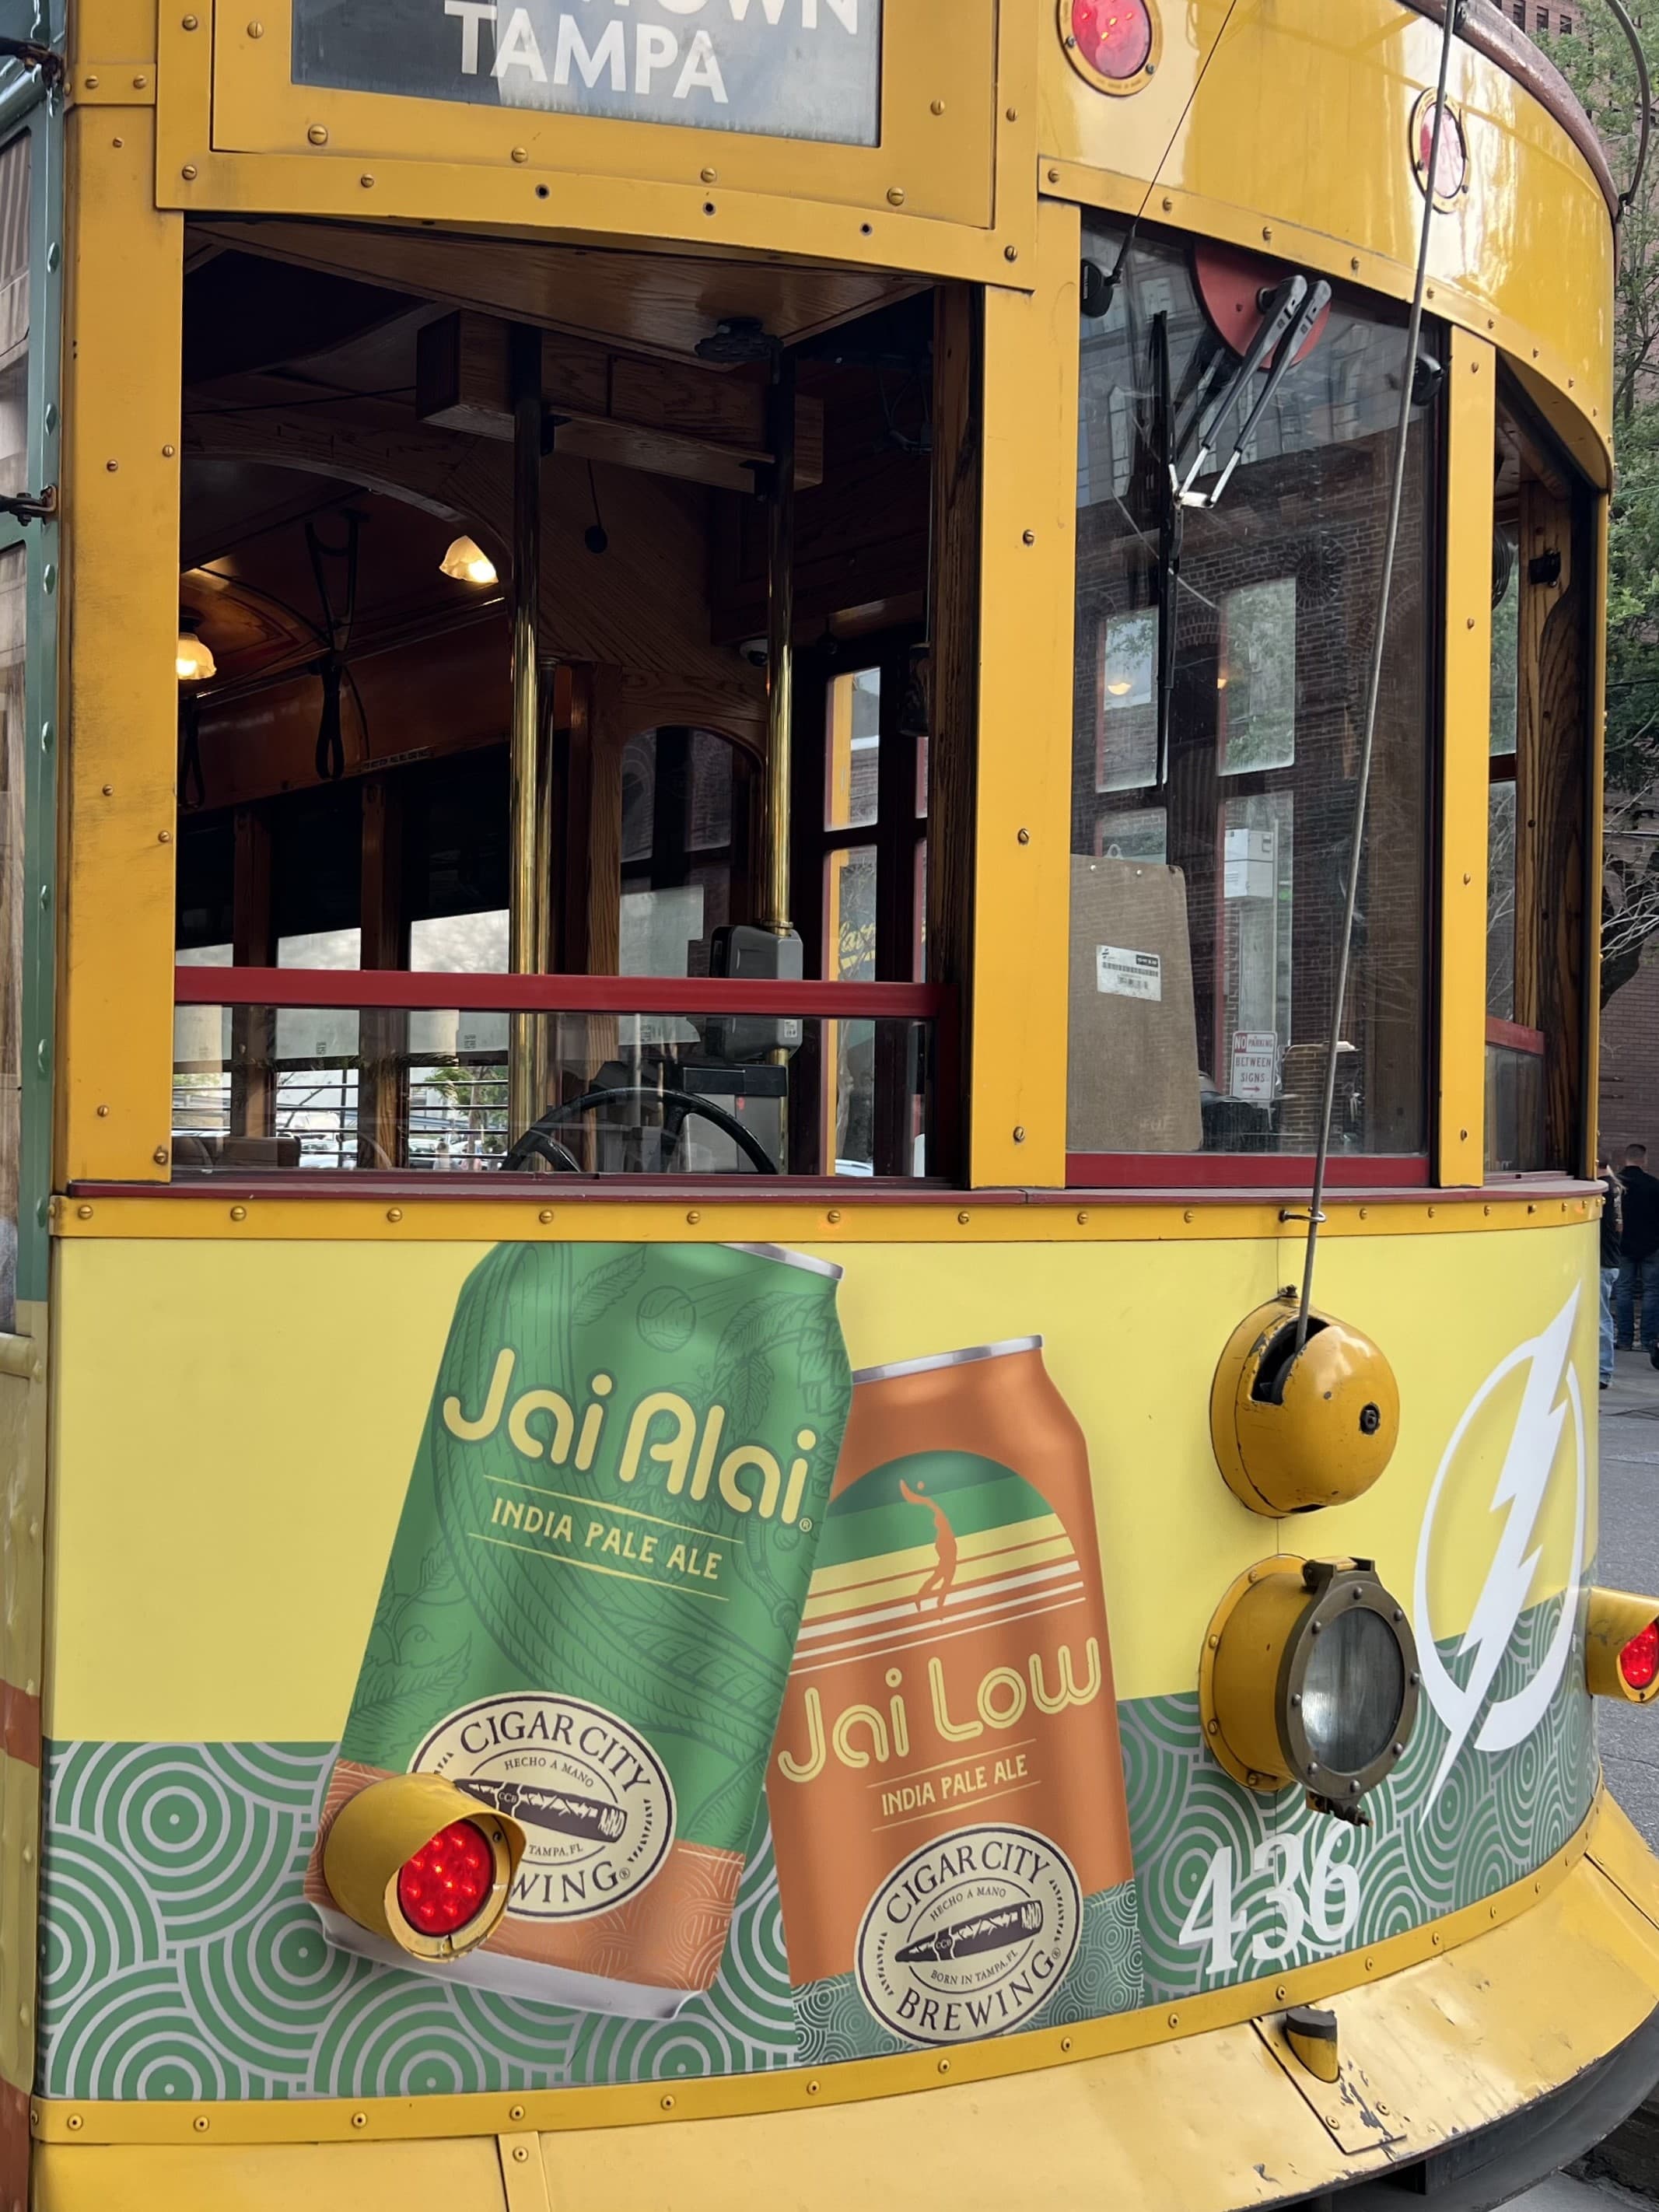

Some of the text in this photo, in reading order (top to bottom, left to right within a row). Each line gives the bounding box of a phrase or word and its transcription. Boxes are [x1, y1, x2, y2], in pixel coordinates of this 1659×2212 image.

[444, 1, 729, 103] TAMPA
[1234, 1035, 1273, 1049] NO PARKING
[1235, 1056, 1272, 1067] BETWEEN
[1240, 1073, 1265, 1083] SIGNS
[443, 1348, 613, 1471] Jai
[491, 1498, 723, 1580] INDIA PALE ALE
[778, 1636, 1102, 1783] Jai Low
[460, 1711, 651, 1792] CIGAR CITY
[505, 1756, 594, 1788] HECHO A MANO
[881, 1754, 1028, 1817] INDIA PALE ALE
[529, 1843, 583, 1857] TAMPA, FL
[887, 1841, 1051, 1923] CIGAR CITY
[930, 1886, 1006, 1922] HECHO A MANO
[1178, 1819, 1360, 1974] 436
[931, 1949, 1018, 1985] BORN IN TAMPA, FL
